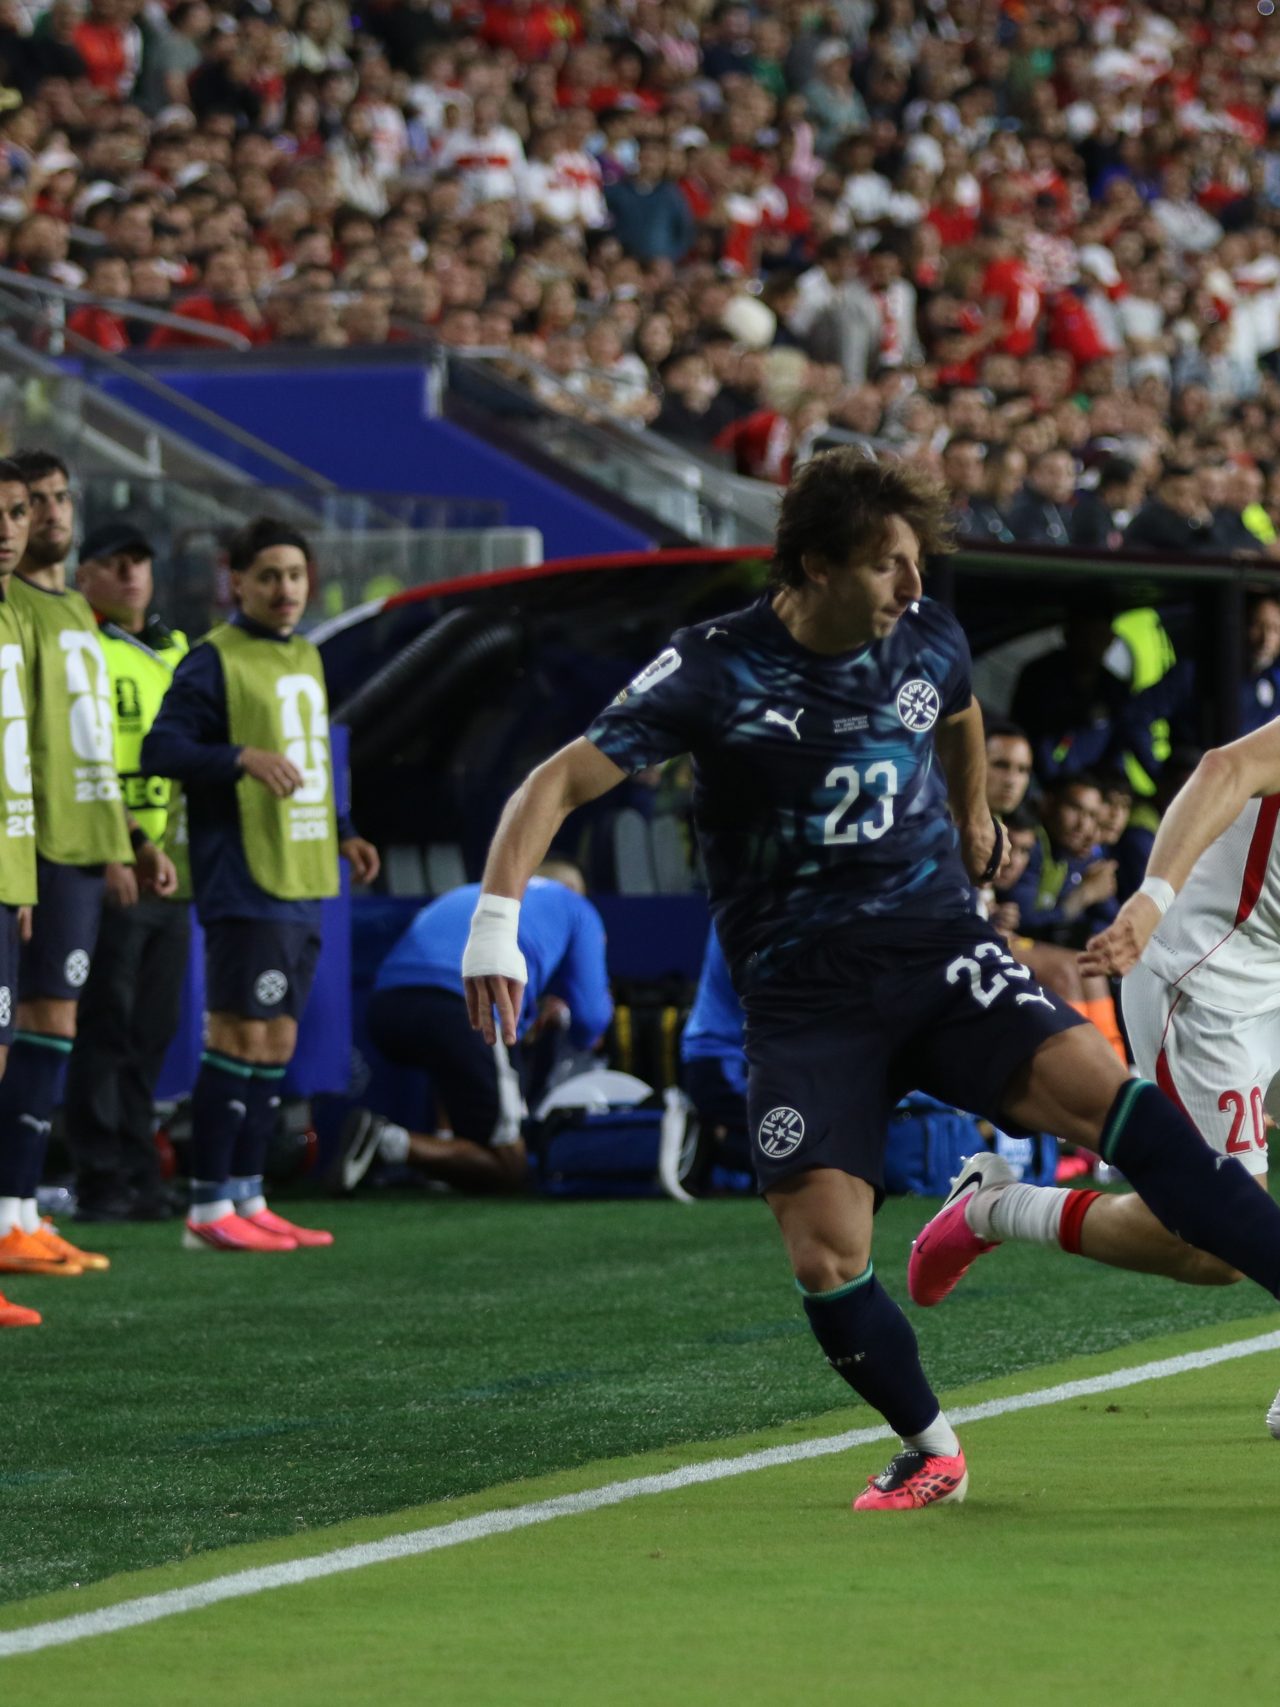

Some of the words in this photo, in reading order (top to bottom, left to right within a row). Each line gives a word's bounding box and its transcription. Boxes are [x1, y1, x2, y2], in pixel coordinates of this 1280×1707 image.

[908, 683, 924, 695] APF
[823, 760, 898, 845] 23
[946, 942, 1031, 1008] 23
[770, 1110, 786, 1122] APF
[1217, 1086, 1267, 1155] 20
